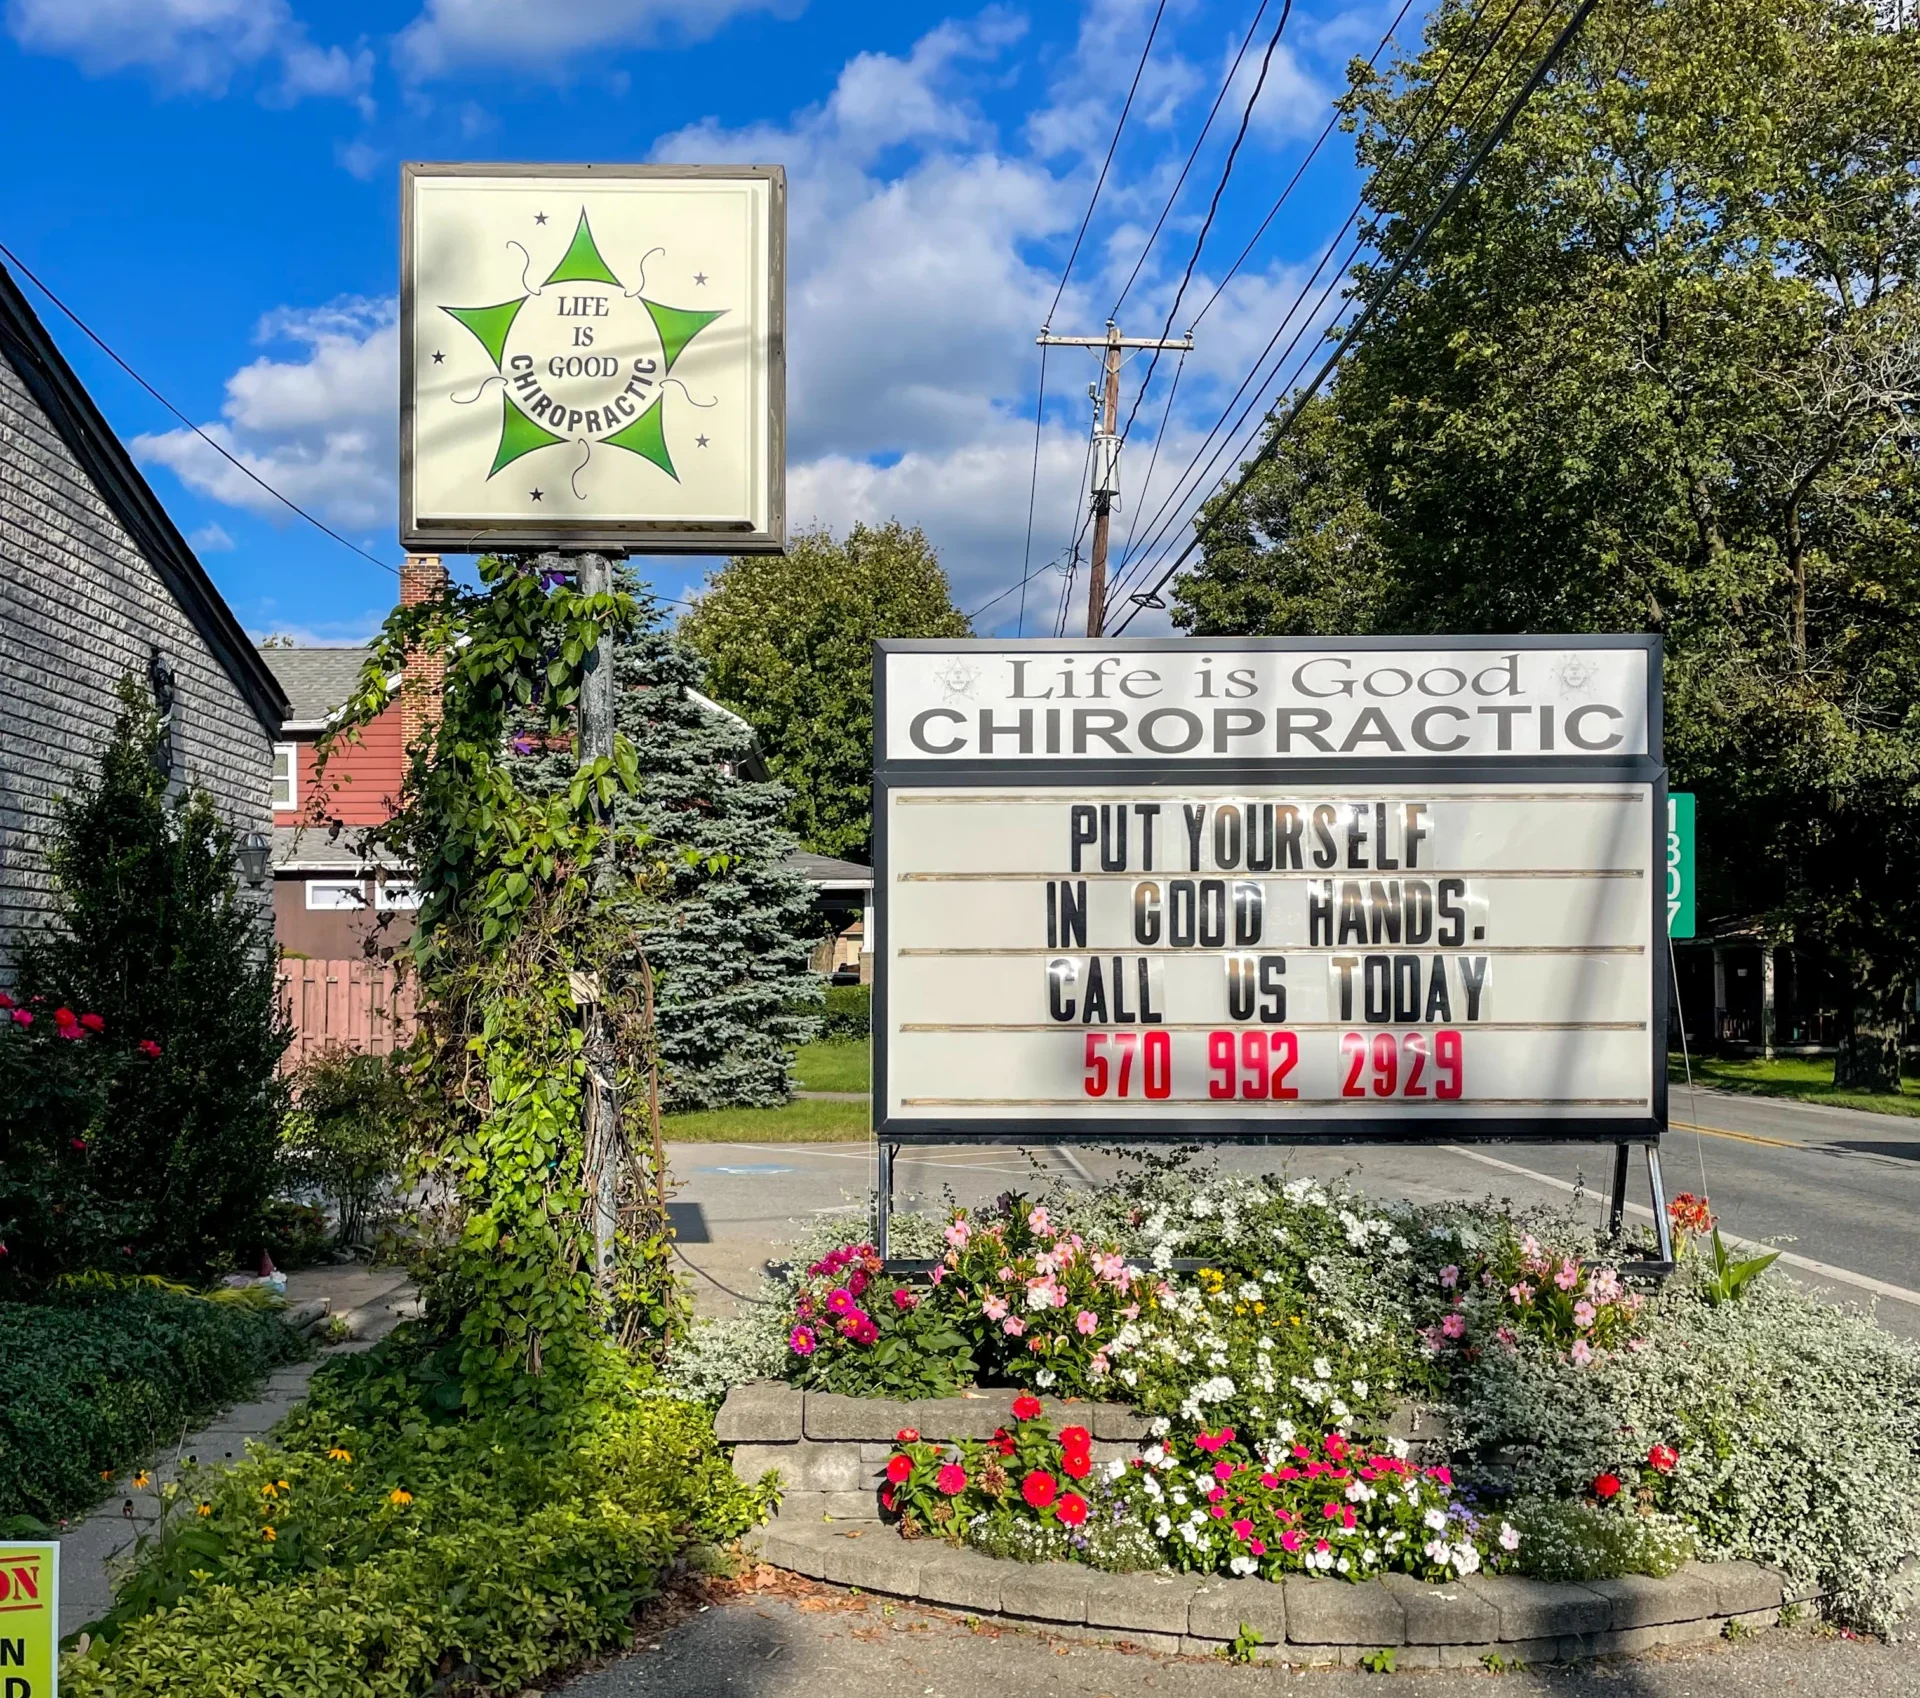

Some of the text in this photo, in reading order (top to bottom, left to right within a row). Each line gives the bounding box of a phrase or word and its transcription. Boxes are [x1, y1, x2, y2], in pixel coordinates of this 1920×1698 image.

[557, 296, 609, 317] LIFE
[572, 326, 594, 347] IS
[511, 354, 657, 433] CHIROPRACTIC
[548, 357, 618, 379] GOOD
[1006, 657, 1164, 699] Life
[1194, 657, 1259, 699] is
[1291, 654, 1526, 699] Good
[909, 704, 1625, 755] CHIROPRACTIC
[1071, 803, 1428, 873] PUT YOURSELF
[1046, 879, 1486, 949] IN GOOD HANDS.
[1050, 955, 1489, 1024] CALL US TODAY
[1084, 1030, 1463, 1100] 570 992 2929
